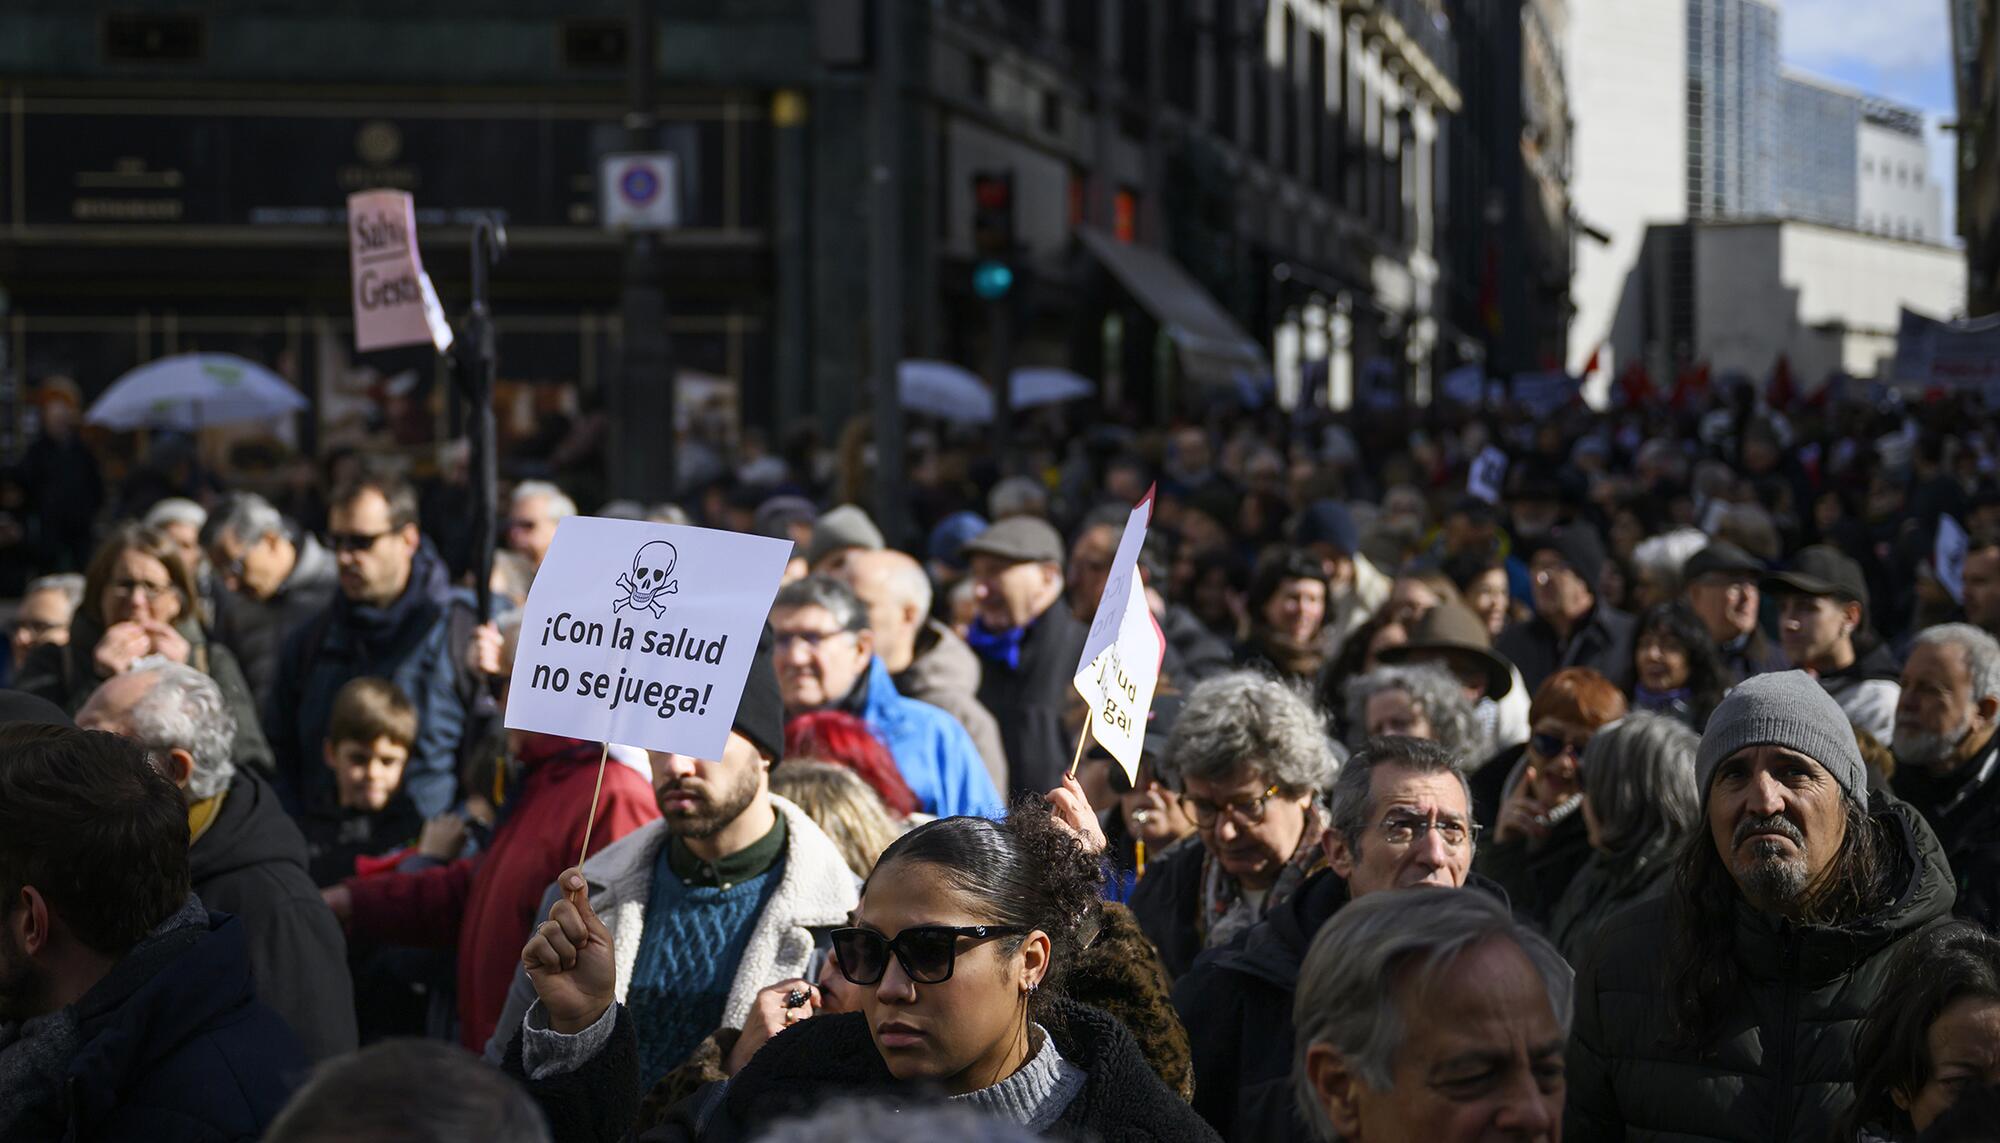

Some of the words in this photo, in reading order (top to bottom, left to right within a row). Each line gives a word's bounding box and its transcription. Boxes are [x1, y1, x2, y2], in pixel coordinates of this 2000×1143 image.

[541, 612, 604, 647] ¡Con
[611, 618, 634, 650] la
[640, 628, 728, 665] salud
[531, 663, 569, 692] no
[577, 670, 610, 699] se
[609, 667, 713, 719] juega!
